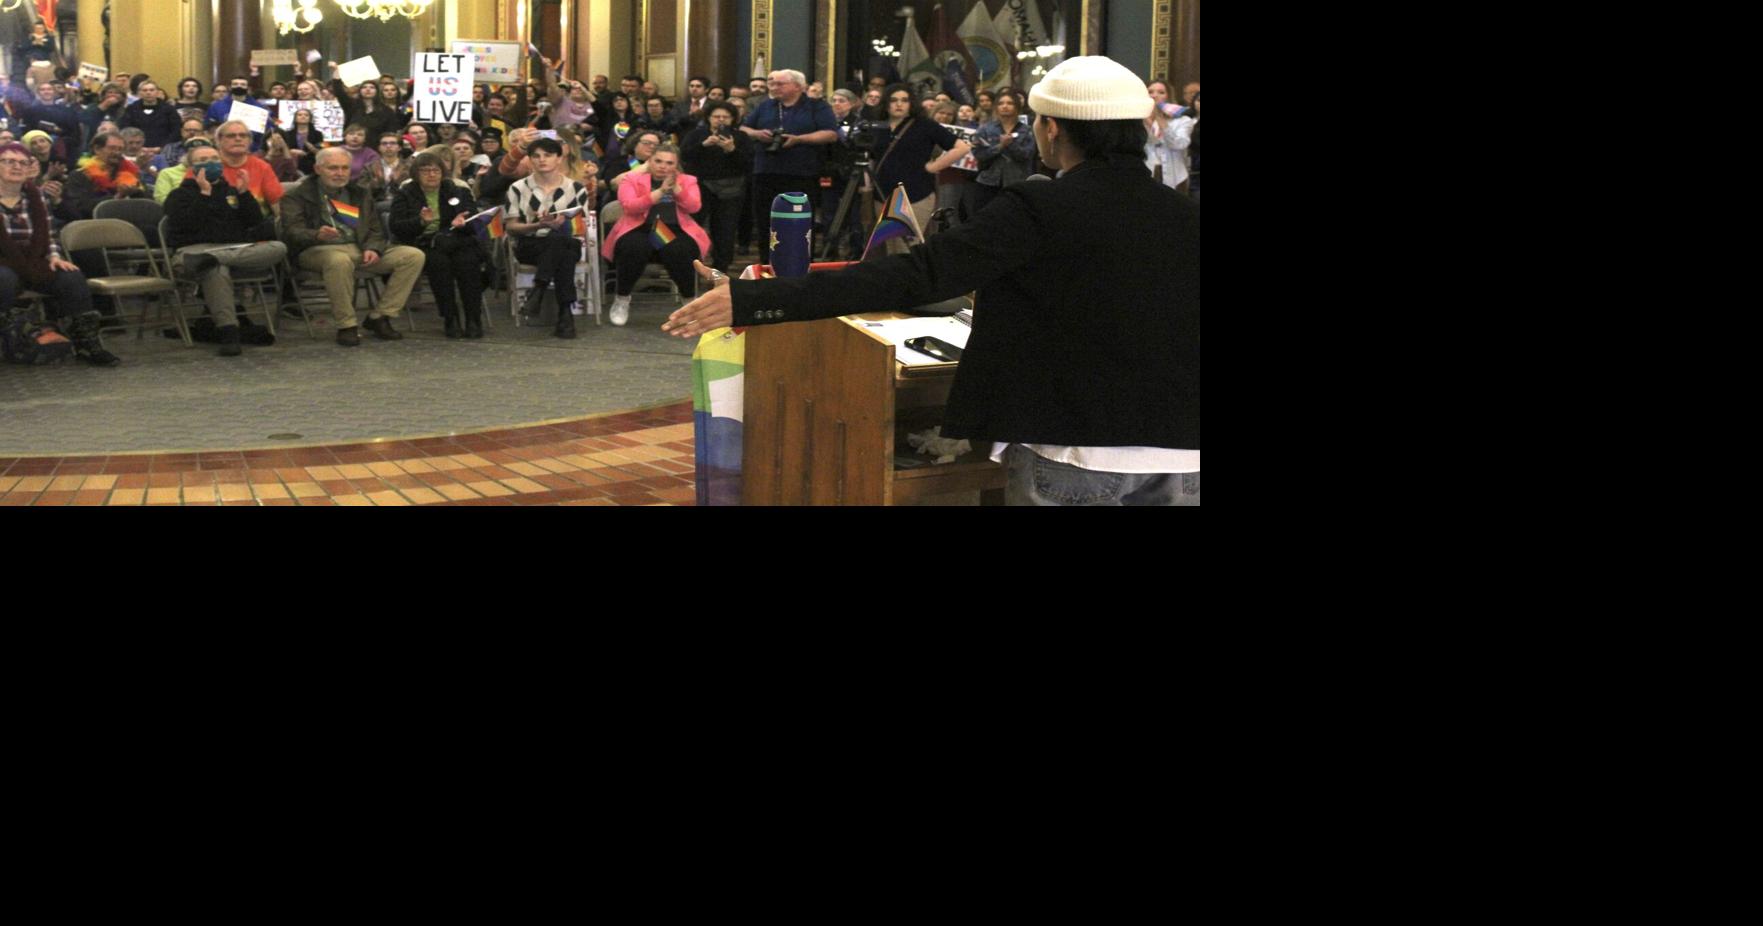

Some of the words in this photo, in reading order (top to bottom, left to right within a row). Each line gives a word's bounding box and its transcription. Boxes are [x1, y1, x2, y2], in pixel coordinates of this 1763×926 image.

[423, 54, 466, 73] LET
[428, 76, 460, 96] US
[416, 100, 471, 123] LIVE
